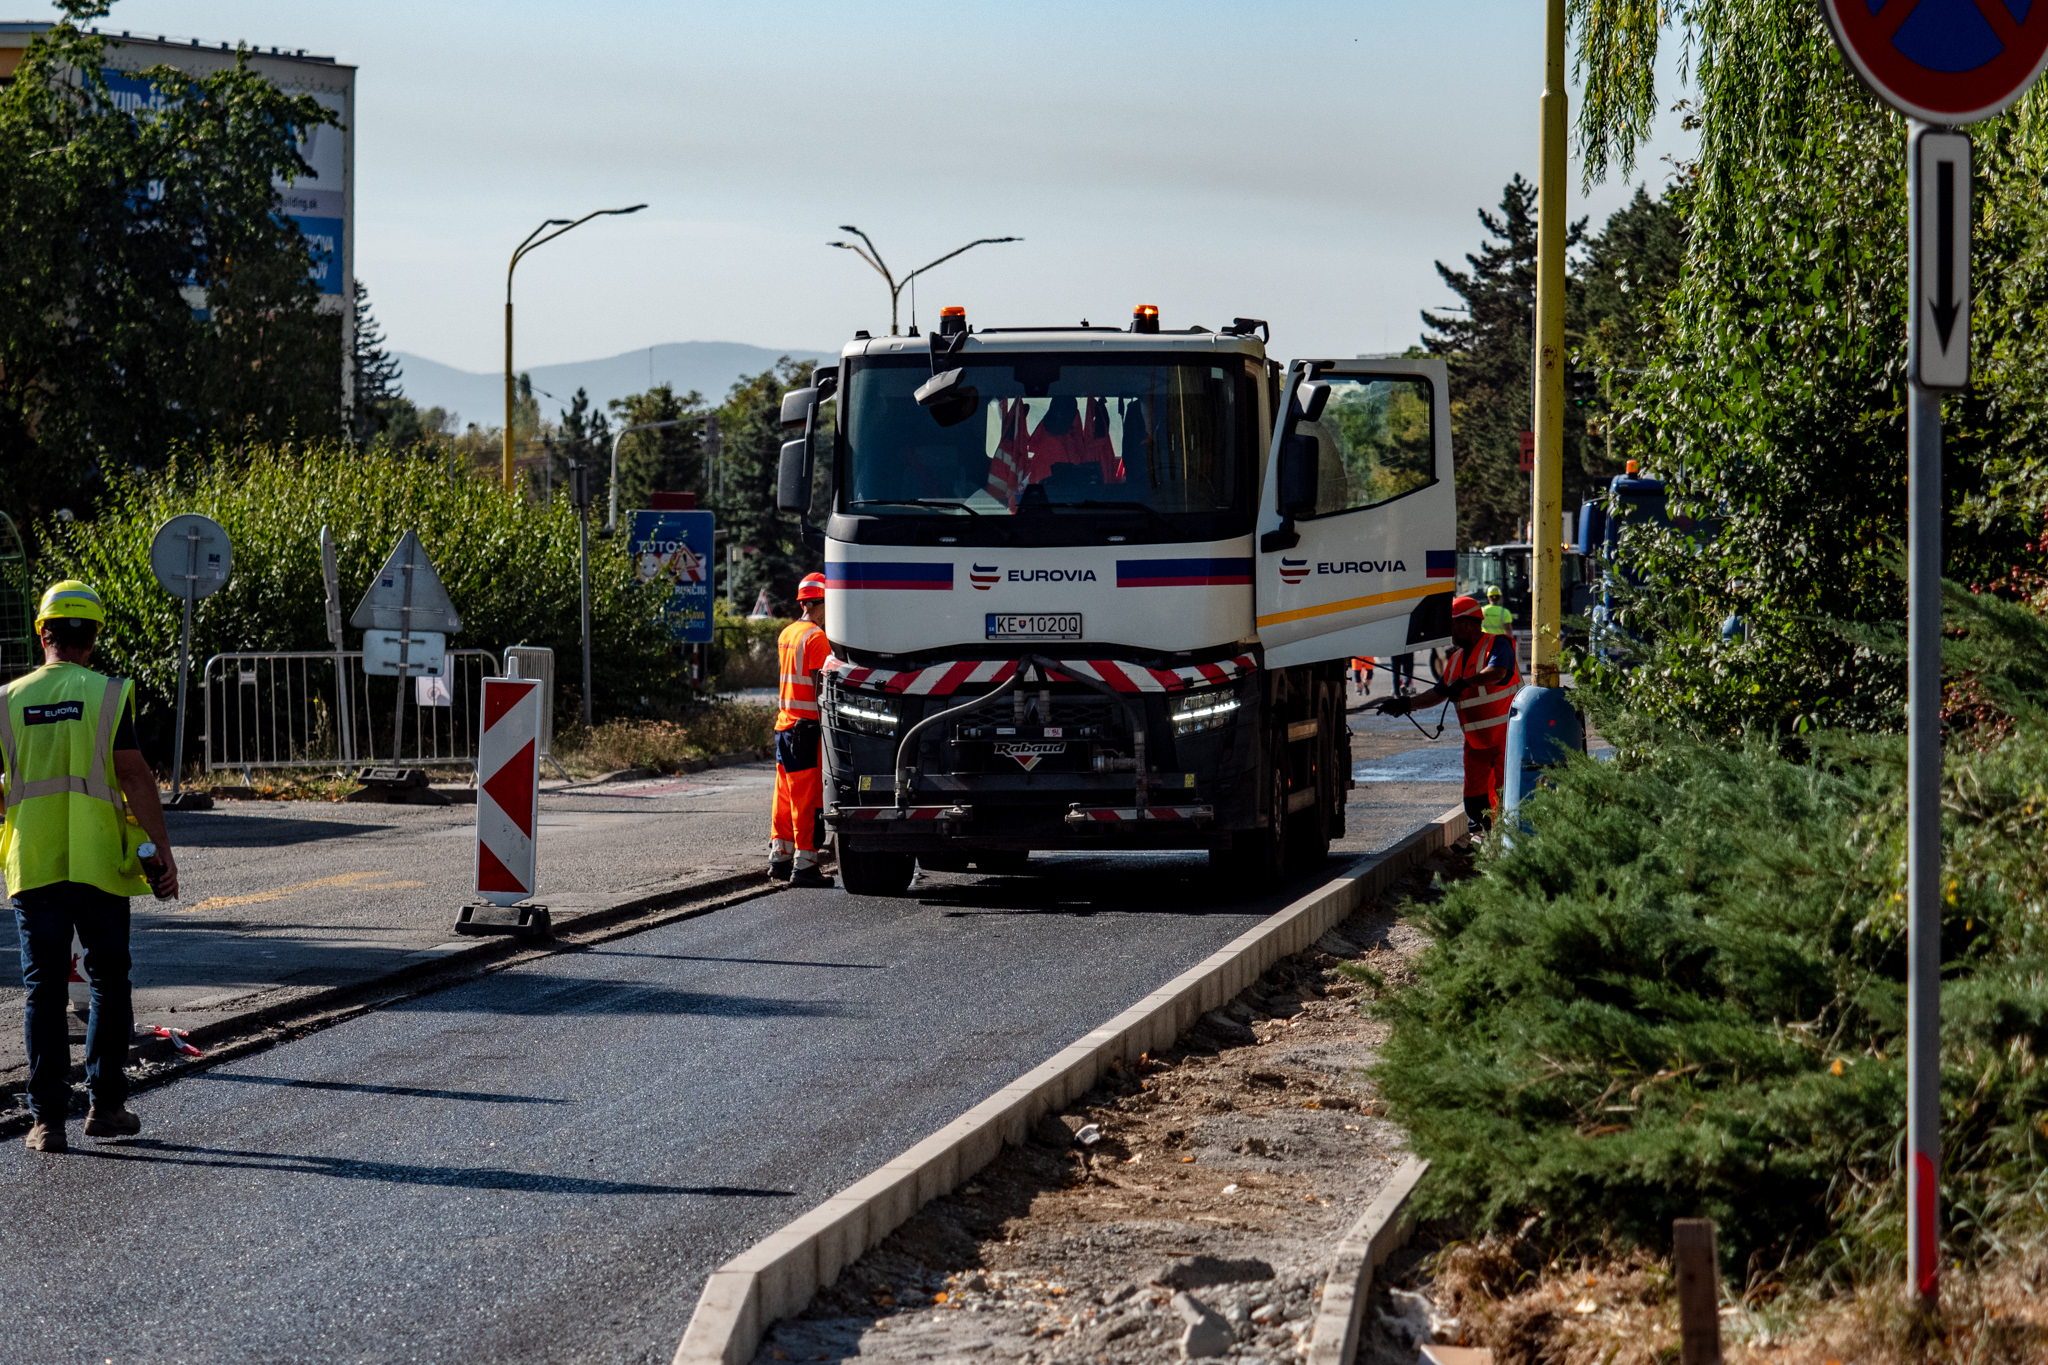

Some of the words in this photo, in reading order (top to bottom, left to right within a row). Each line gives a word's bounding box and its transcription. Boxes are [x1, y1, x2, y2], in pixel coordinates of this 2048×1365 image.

[636, 540, 678, 554] TUTO
[1317, 560, 1407, 575] EUROVIA
[1008, 569, 1097, 582] EUROVIA
[997, 616, 1017, 632] KE
[1029, 616, 1078, 632] 1020Q
[995, 742, 1066, 757] Rabaud
